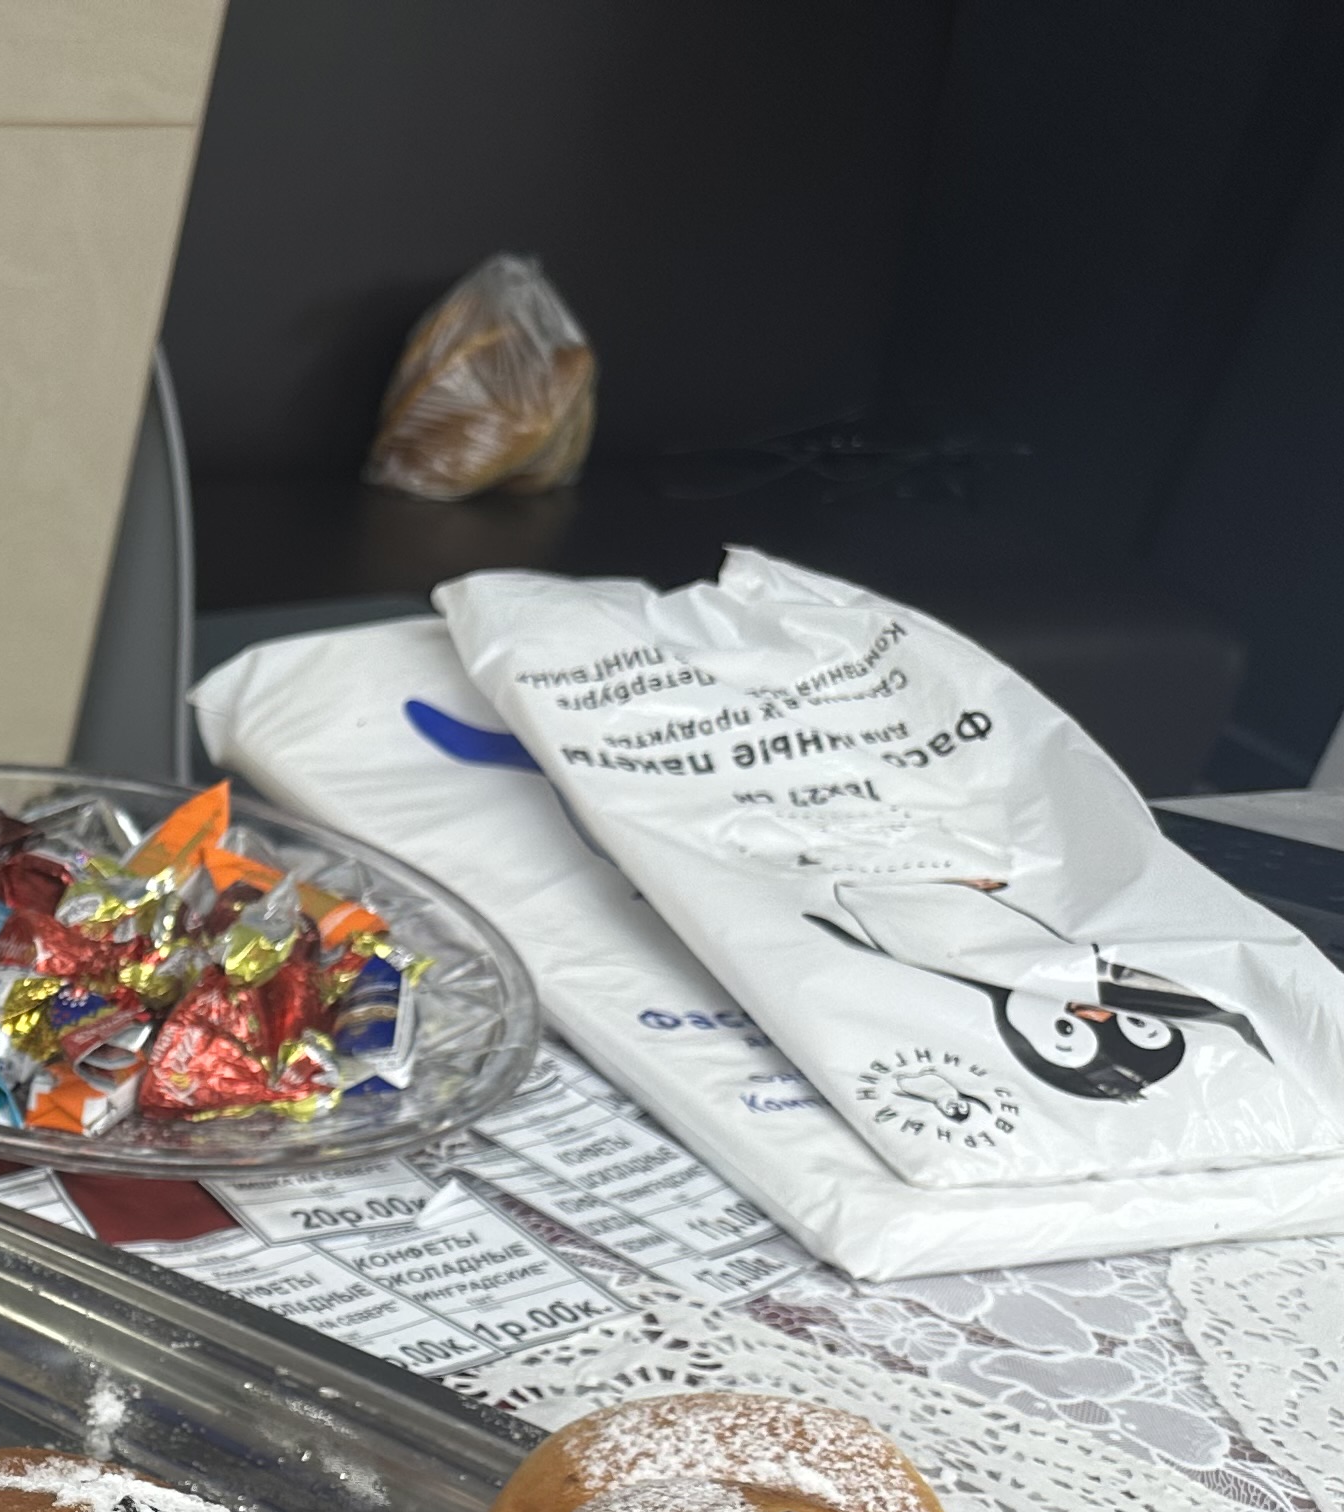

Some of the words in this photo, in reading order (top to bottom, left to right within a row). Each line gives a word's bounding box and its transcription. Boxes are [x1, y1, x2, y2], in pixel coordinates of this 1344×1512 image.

[560, 747, 717, 776] пакеты
[290, 1197, 432, 1230] 20р.00к
[353, 1230, 480, 1272] КОНФЕТЫ
[376, 1241, 533, 1290] ОКОЛАДНЫЕ
[226, 1271, 325, 1300] ОНФЕТЫ
[267, 1281, 374, 1317] ОЛАДНЫЕ
[471, 1299, 612, 1343] 1р.00к.
